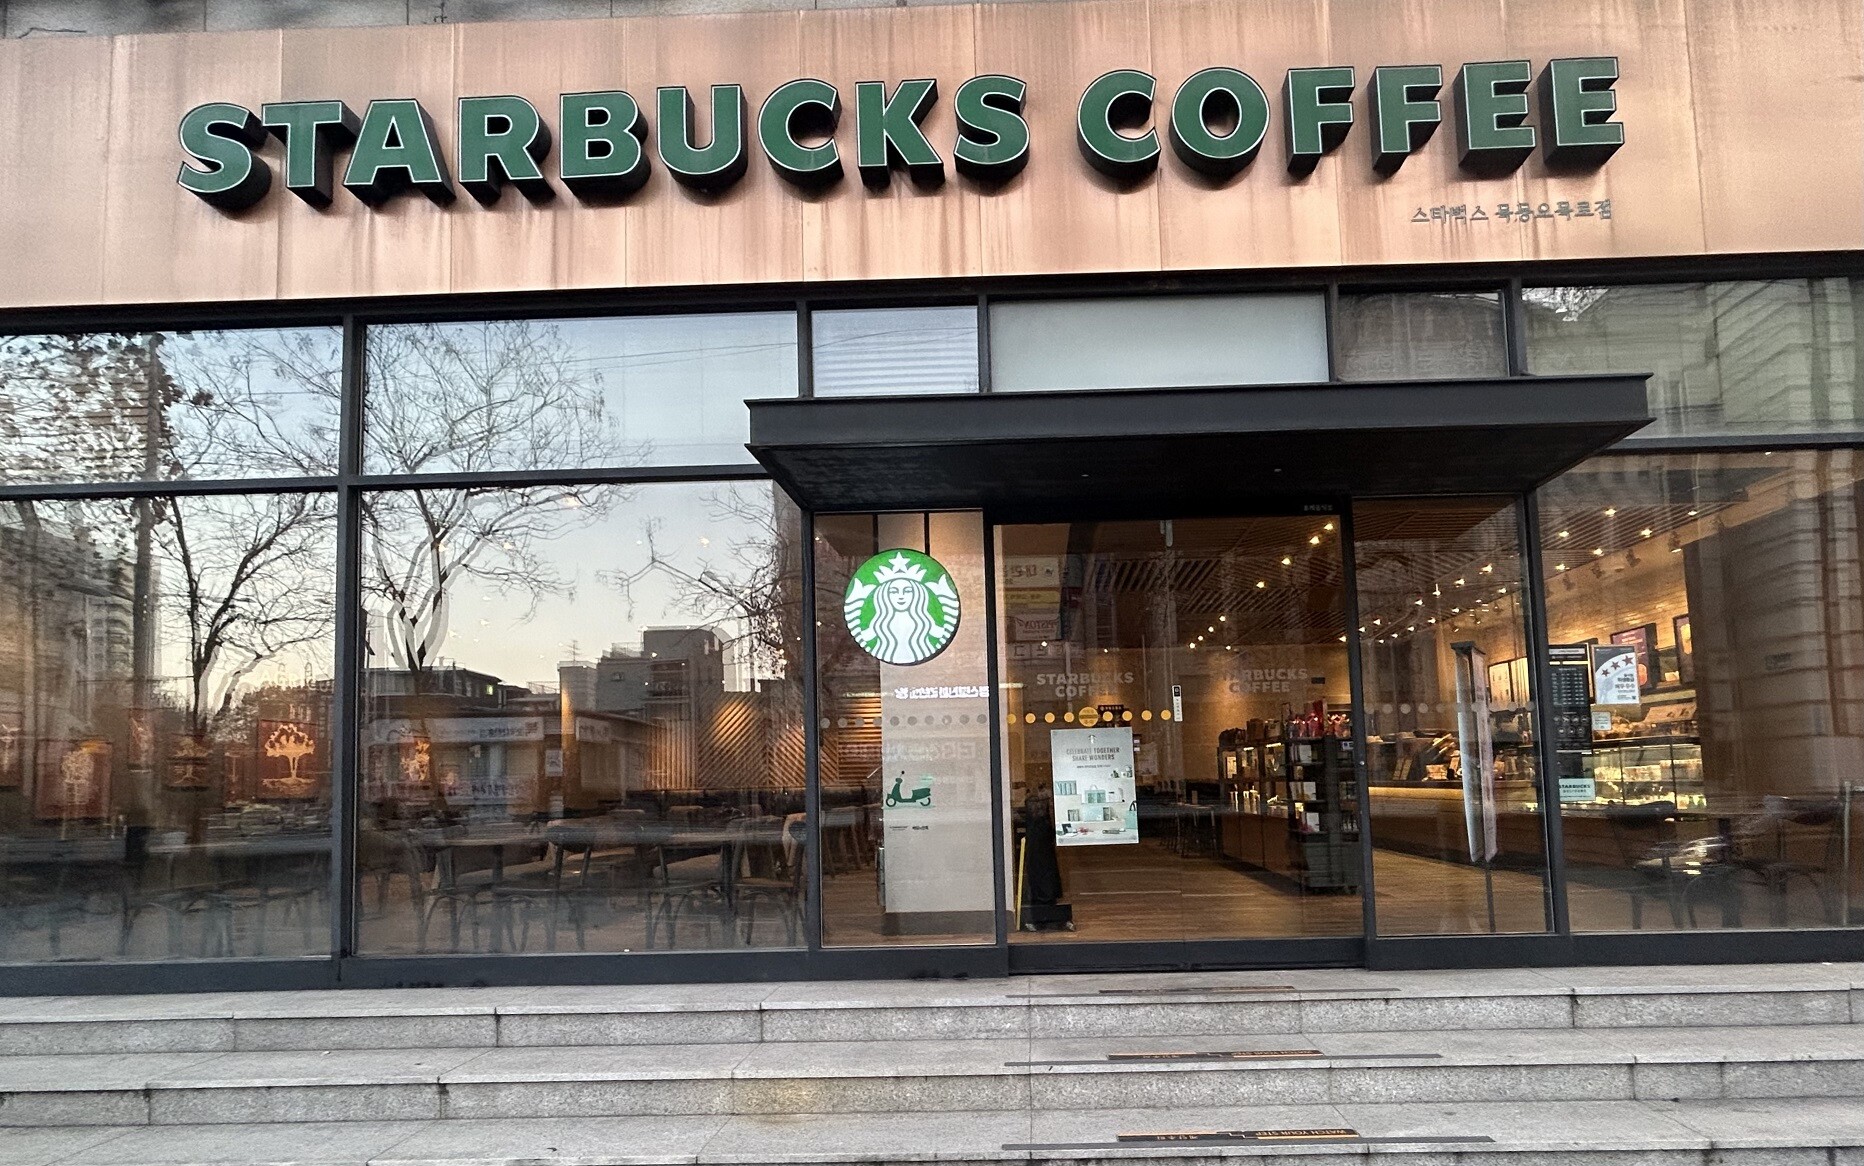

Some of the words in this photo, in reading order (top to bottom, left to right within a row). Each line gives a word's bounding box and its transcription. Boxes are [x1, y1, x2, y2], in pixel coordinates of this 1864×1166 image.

[177, 74, 1029, 195] STARBUCKS
[1077, 56, 1625, 164] COFFEE
[1411, 203, 1489, 224] 스타벅스
[1495, 198, 1612, 224] 목동오목로점
[1036, 671, 1134, 686] STARBUKS
[1054, 685, 1118, 699] COFF
[1089, 753, 1115, 761] WONDERS
[1093, 746, 1120, 754] TOGETHER
